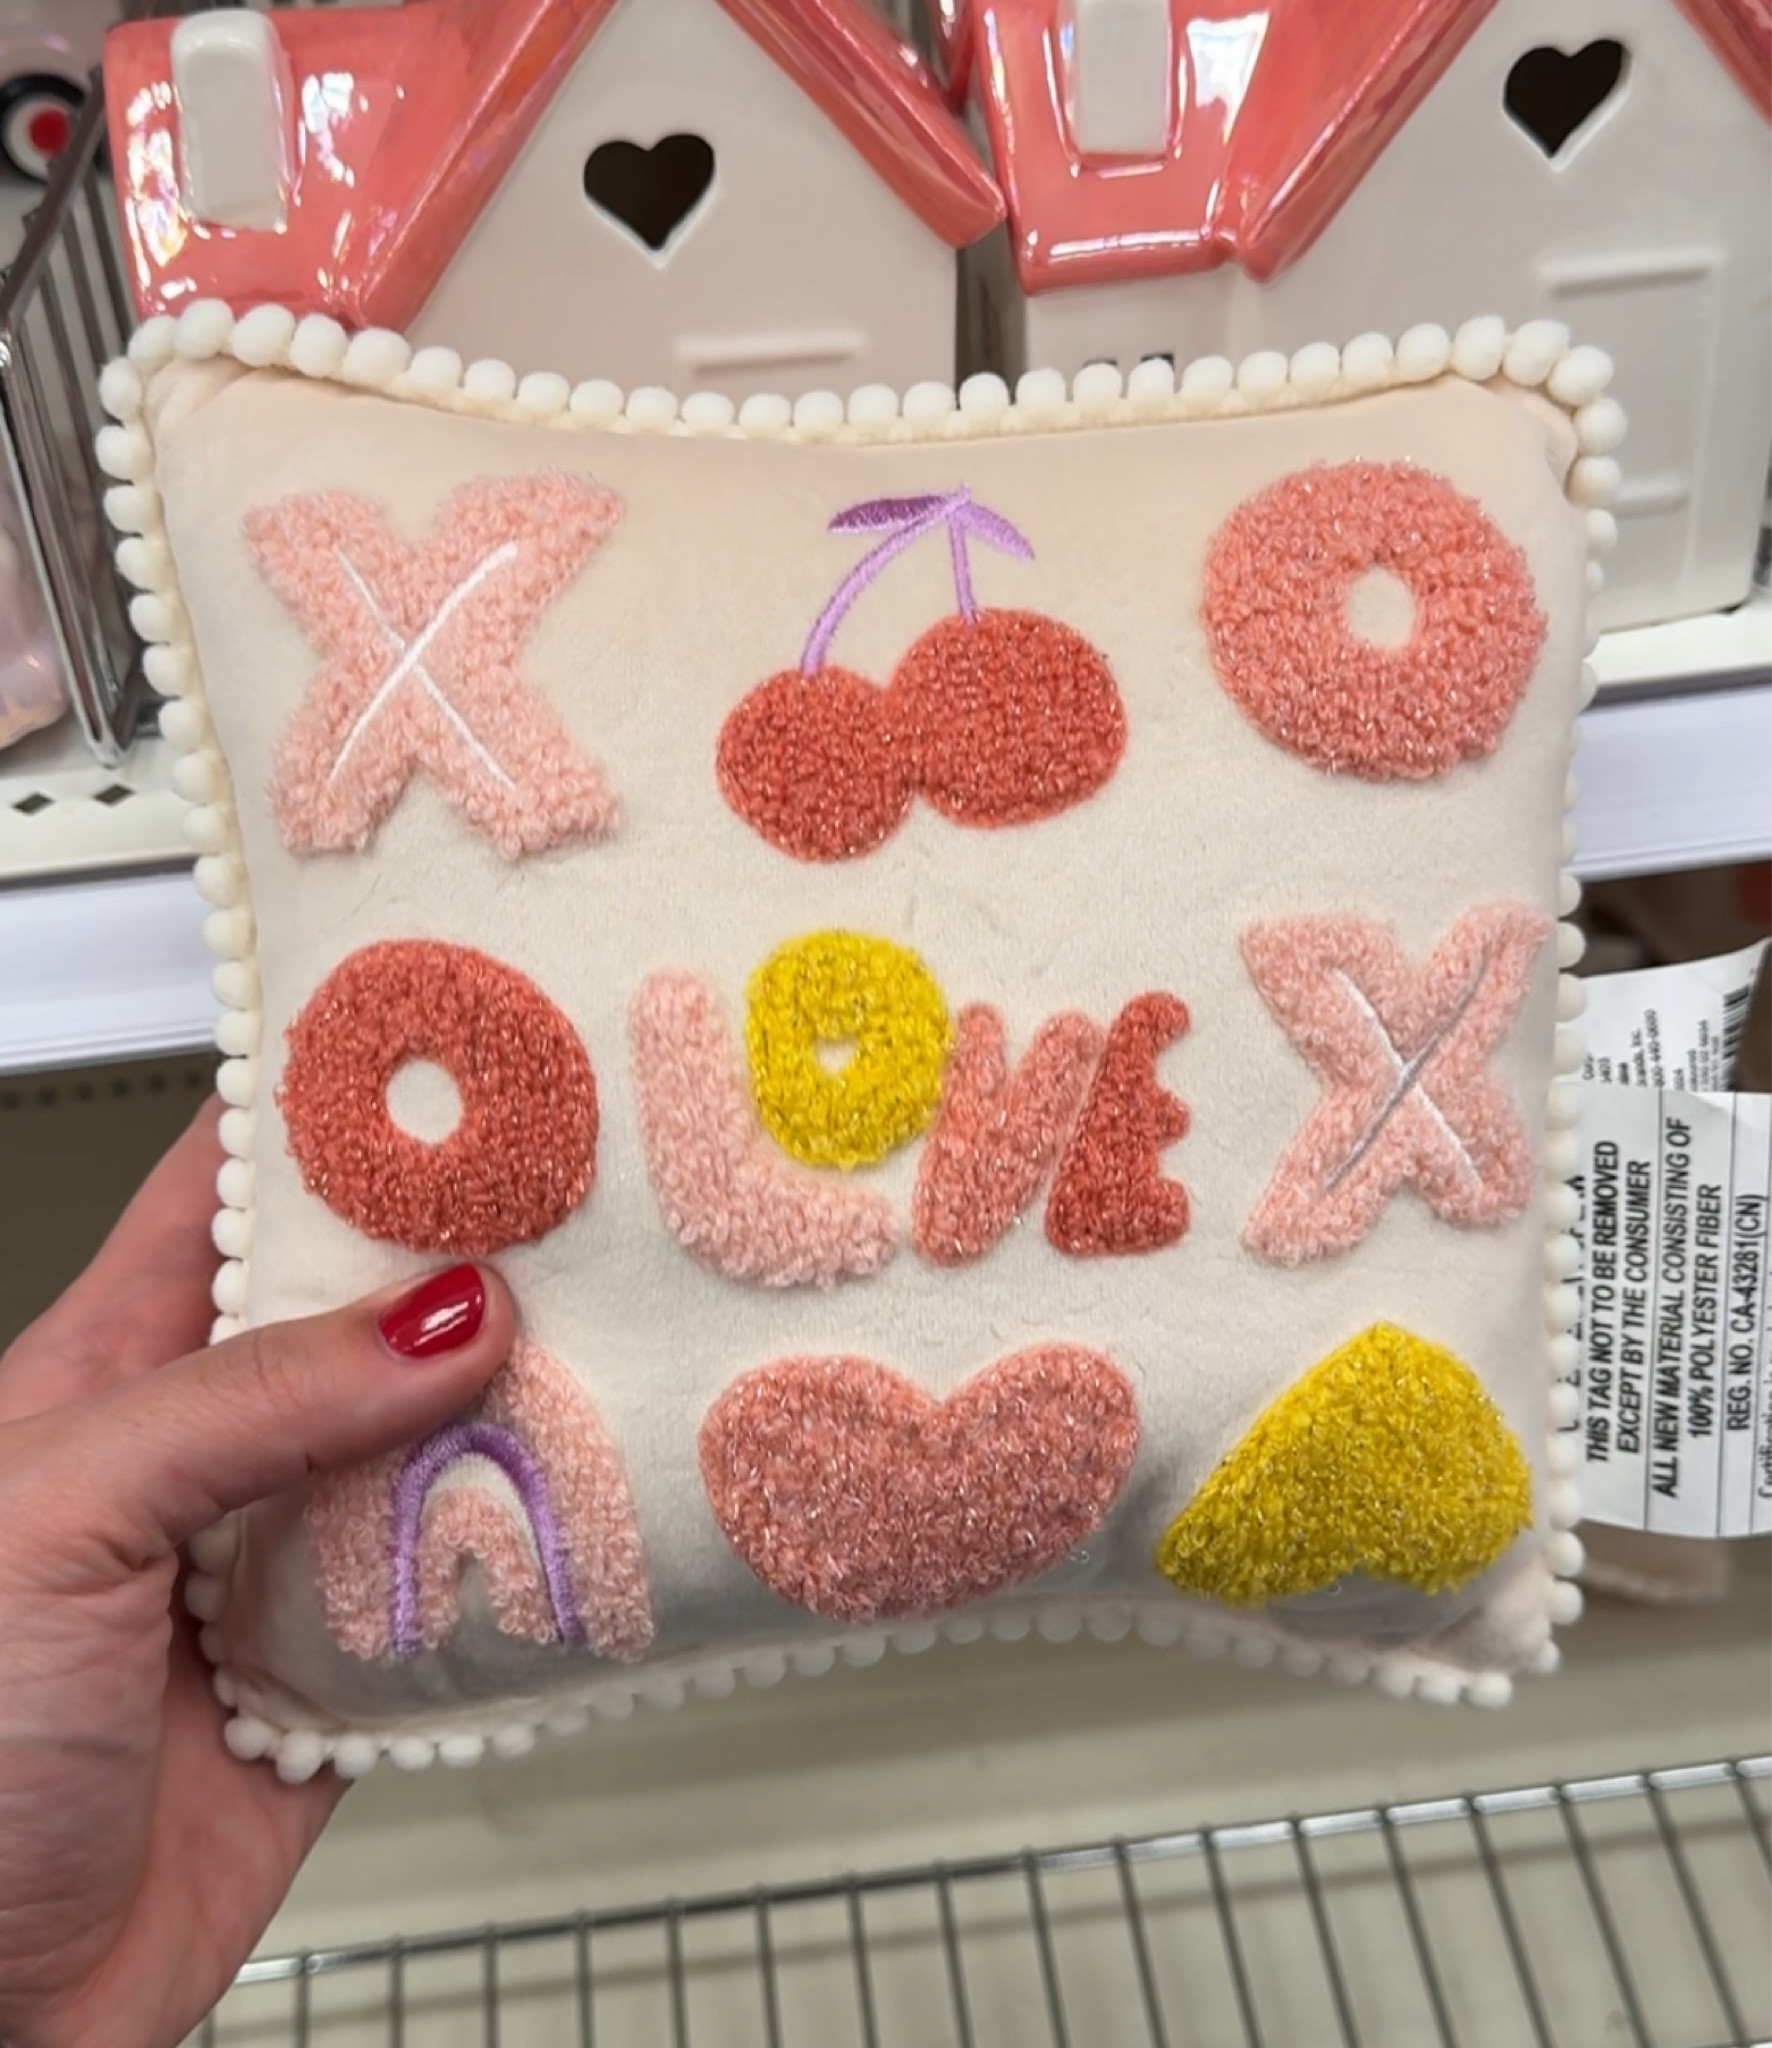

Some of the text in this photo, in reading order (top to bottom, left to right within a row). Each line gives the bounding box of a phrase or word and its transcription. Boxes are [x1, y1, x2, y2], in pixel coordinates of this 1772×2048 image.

[242, 458, 1549, 861] X O
[277, 900, 1551, 1291] O LOVE X
[1665, 1117, 1692, 1148] OF
[1586, 1141, 1619, 1462] THIS TAG NOT TO BE REMOVED
[1617, 1160, 1651, 1454] EXCEPT BY THE CONSUMER
[1661, 1152, 1690, 1284] CONSISTING
[1687, 1184, 1722, 1438] 100% POLYESTER FIBER
[1726, 1194, 1769, 1431] REG. NO. CA-43281(CN)
[1653, 1400, 1681, 1452] NEW
[1654, 1290, 1685, 1399] MATERIAL
[1651, 1456, 1679, 1498] ALL
